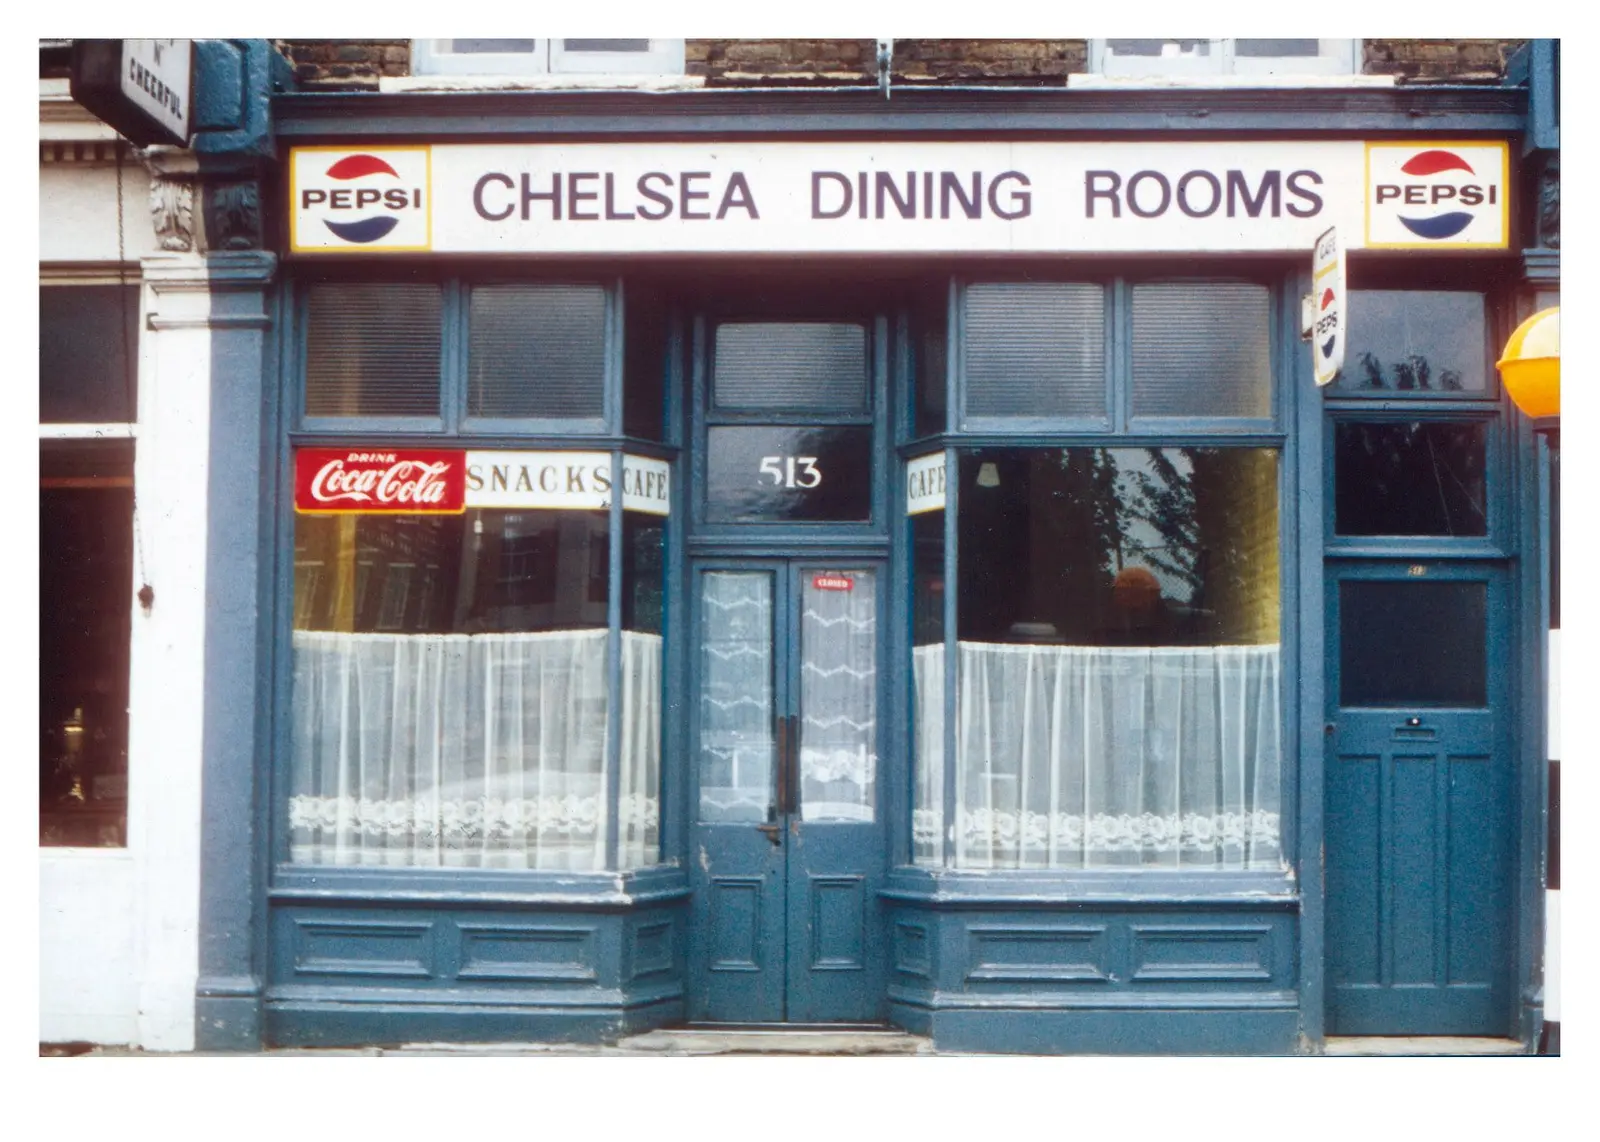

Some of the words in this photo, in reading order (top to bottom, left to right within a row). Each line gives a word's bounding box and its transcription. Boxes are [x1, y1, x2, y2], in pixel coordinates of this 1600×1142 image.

[130, 57, 182, 120] CHEERFUL
[301, 188, 421, 211] PEPSI
[473, 171, 760, 222] CHELSEA
[811, 170, 1032, 220] DINING
[1084, 169, 1325, 219] ROOMS
[1376, 184, 1498, 206] PEPSI
[1316, 311, 1338, 336] PEPS
[347, 453, 398, 463] DRINK
[311, 459, 451, 503] Coca-Cola
[466, 465, 612, 492] SNACKS
[757, 455, 822, 489] 513
[818, 578, 849, 588] CLOSED
